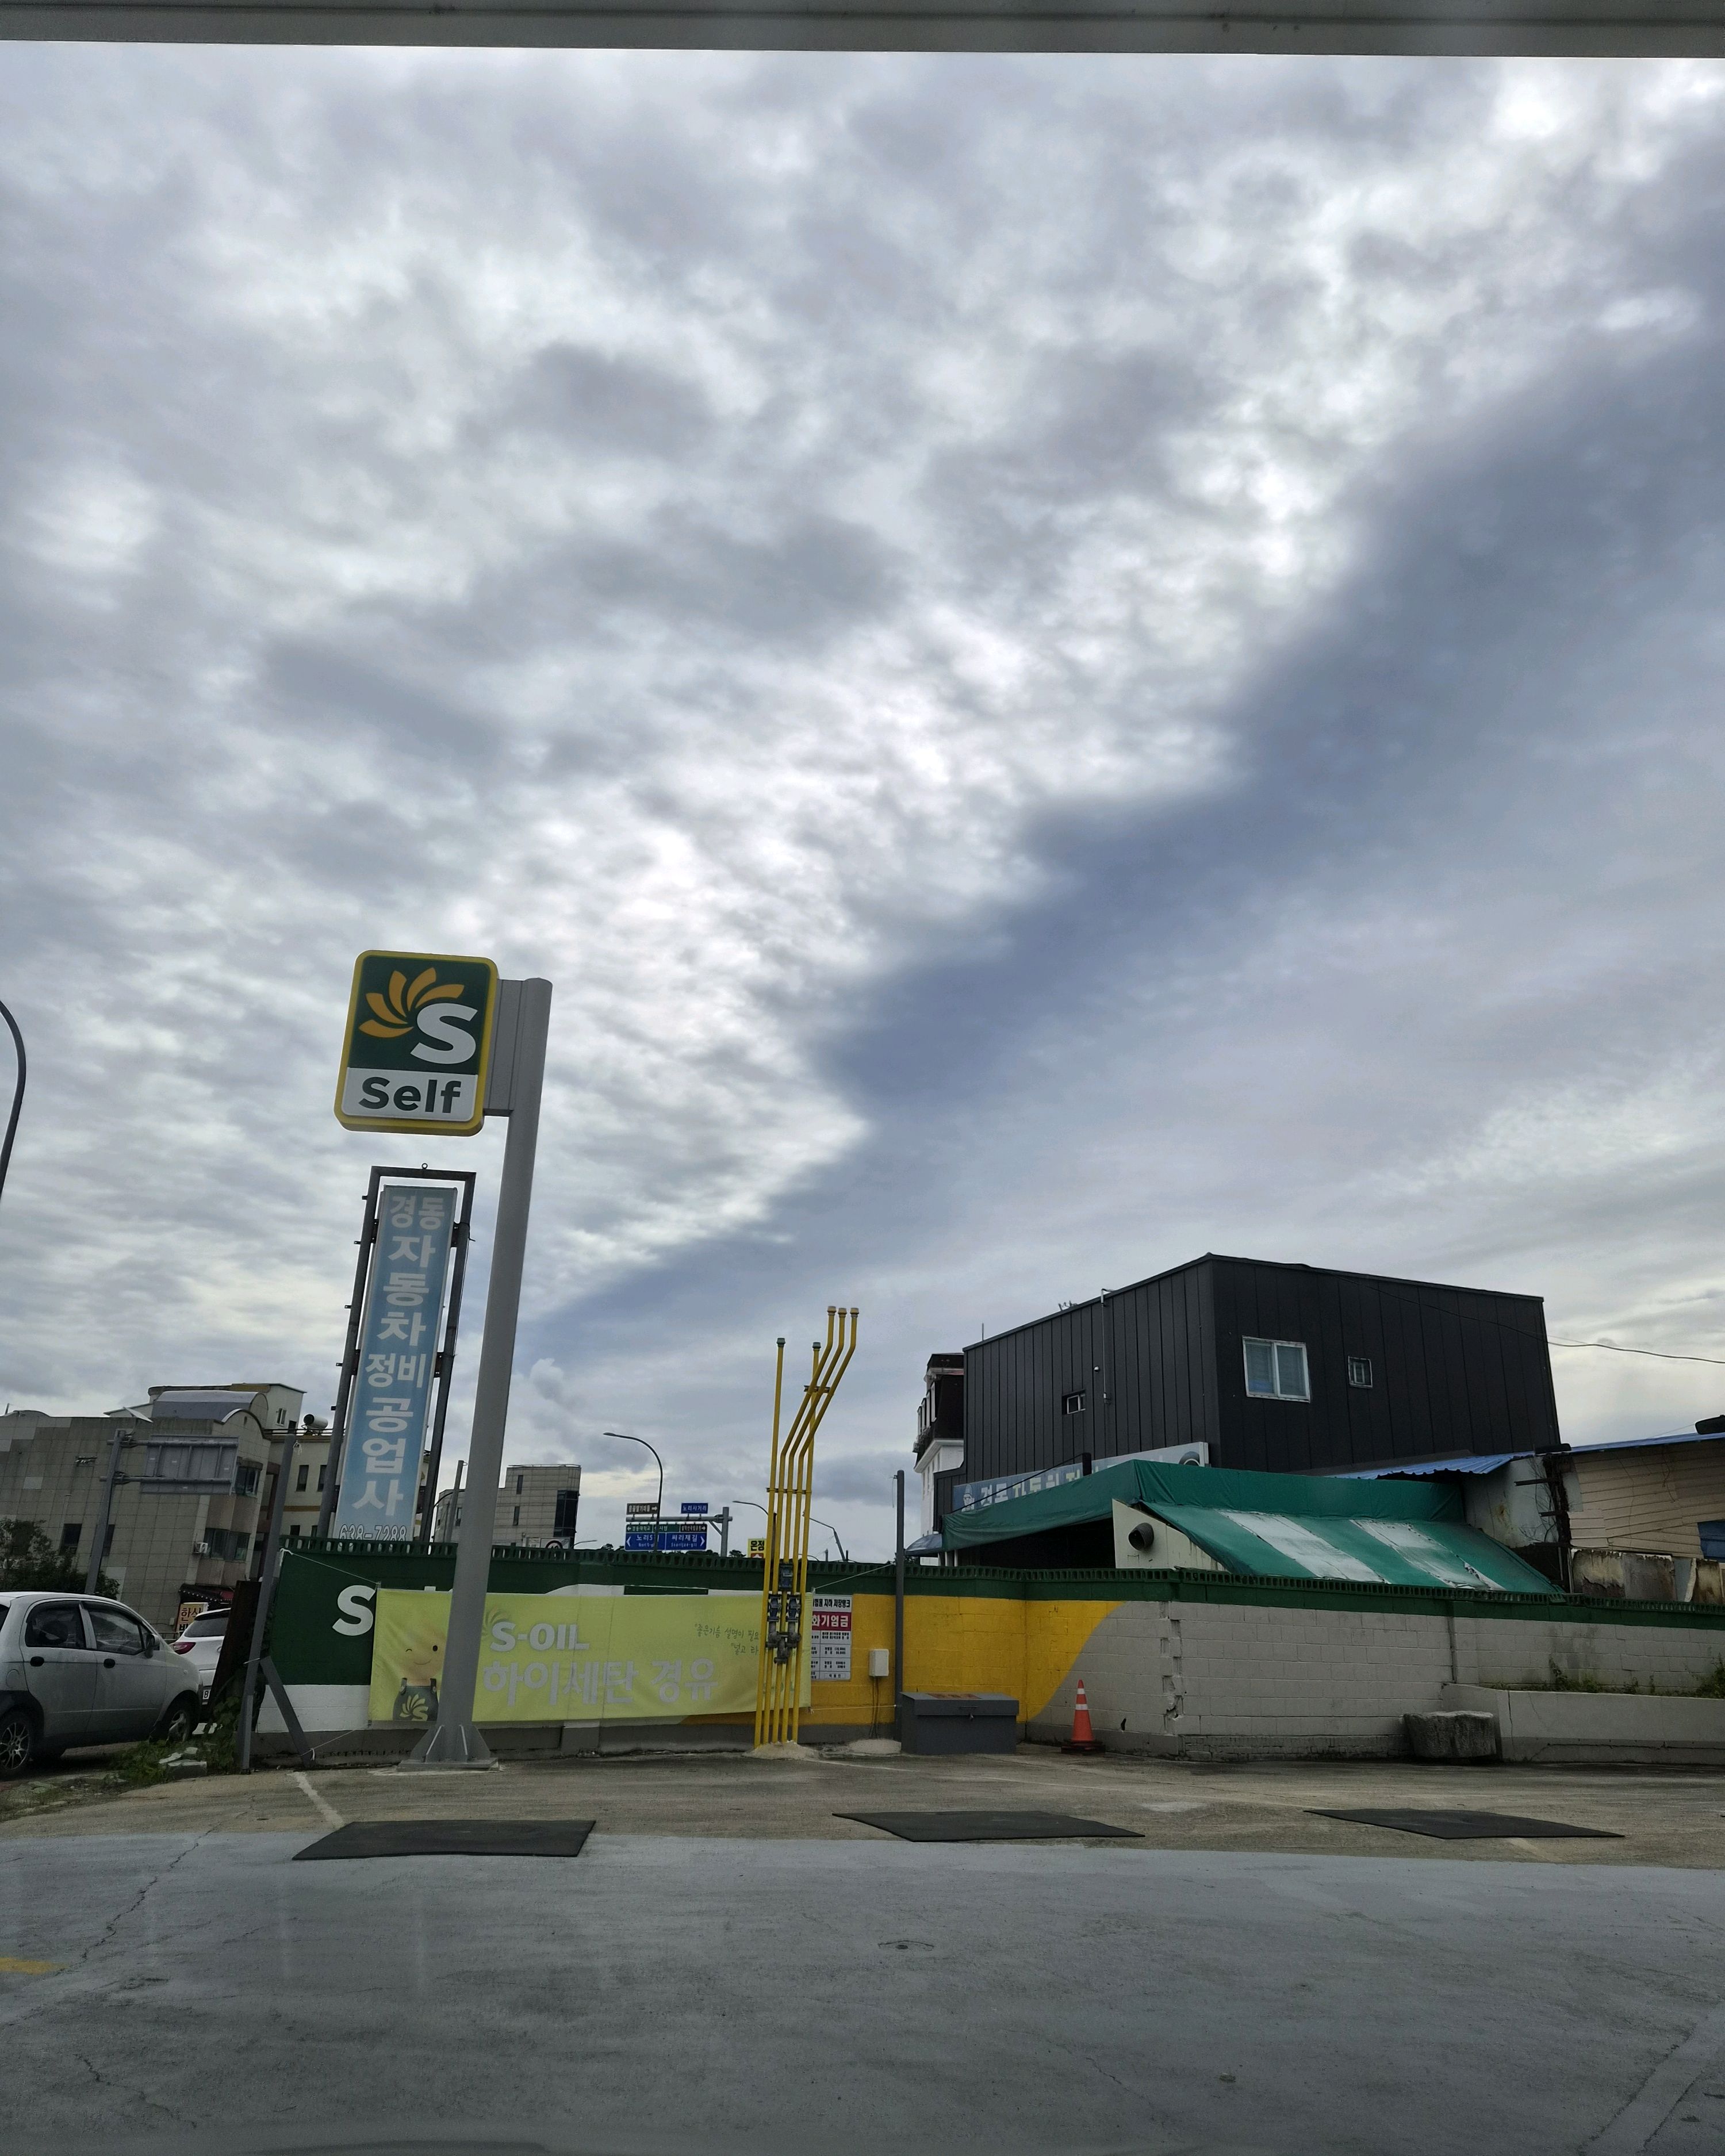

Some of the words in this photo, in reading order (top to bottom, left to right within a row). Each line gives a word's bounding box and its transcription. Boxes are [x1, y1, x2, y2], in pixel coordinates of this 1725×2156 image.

[411, 1003, 478, 1064] S
[359, 1077, 461, 1113] Self
[490, 1621, 589, 1652] S-OIL
[812, 1614, 849, 1628] 화기엄금
[482, 1660, 639, 1707] 하이세탄
[651, 1658, 718, 1704] 경유
